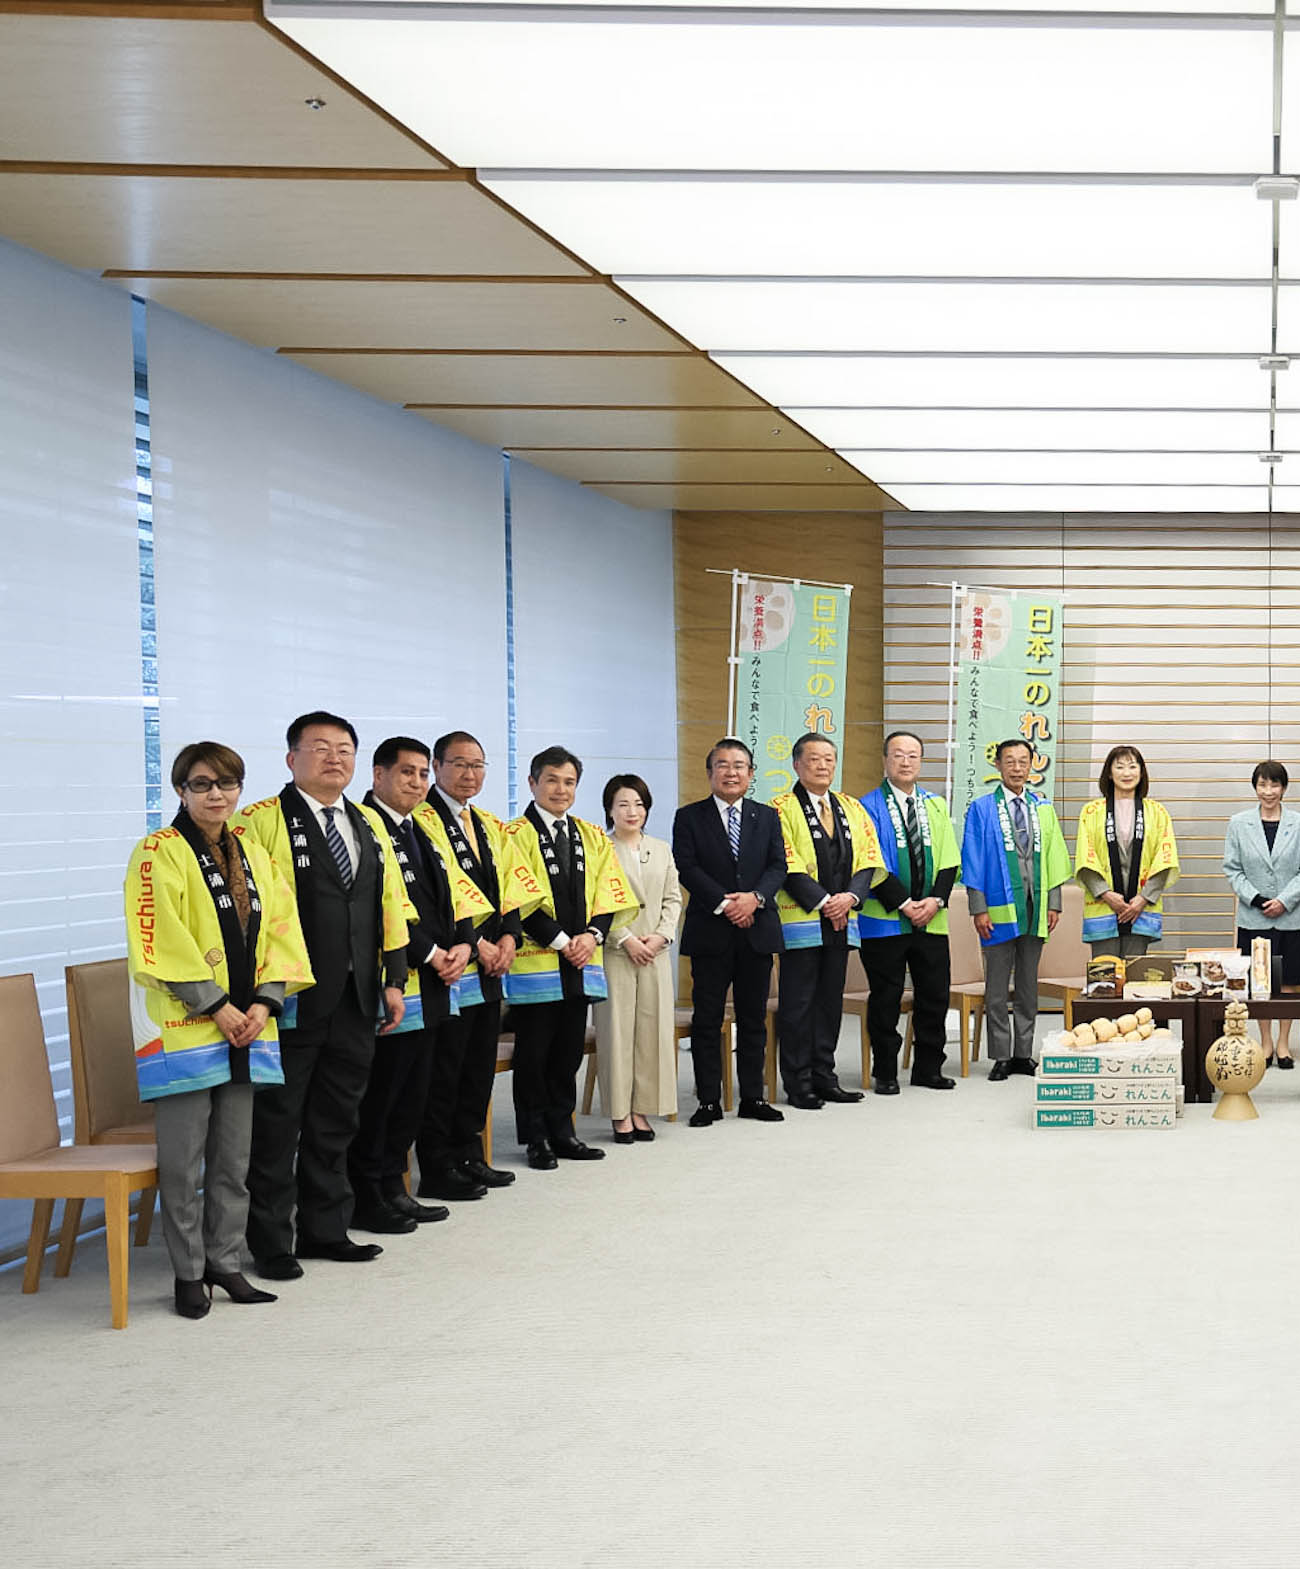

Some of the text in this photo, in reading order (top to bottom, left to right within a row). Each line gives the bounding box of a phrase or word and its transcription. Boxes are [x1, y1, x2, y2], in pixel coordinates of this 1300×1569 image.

[143, 827, 180, 852] City
[290, 816, 311, 869] 土浦市
[448, 825, 473, 870] 土浦市
[198, 853, 234, 910] 土浦市
[513, 865, 541, 894] City
[609, 876, 628, 905] City
[1131, 1063, 1177, 1075] れんこん
[1040, 1087, 1072, 1097] Ibaraki
[1125, 1089, 1172, 1101] れんこん
[1040, 1113, 1072, 1123] Ibaraki
[1125, 1115, 1172, 1126] れんこん
